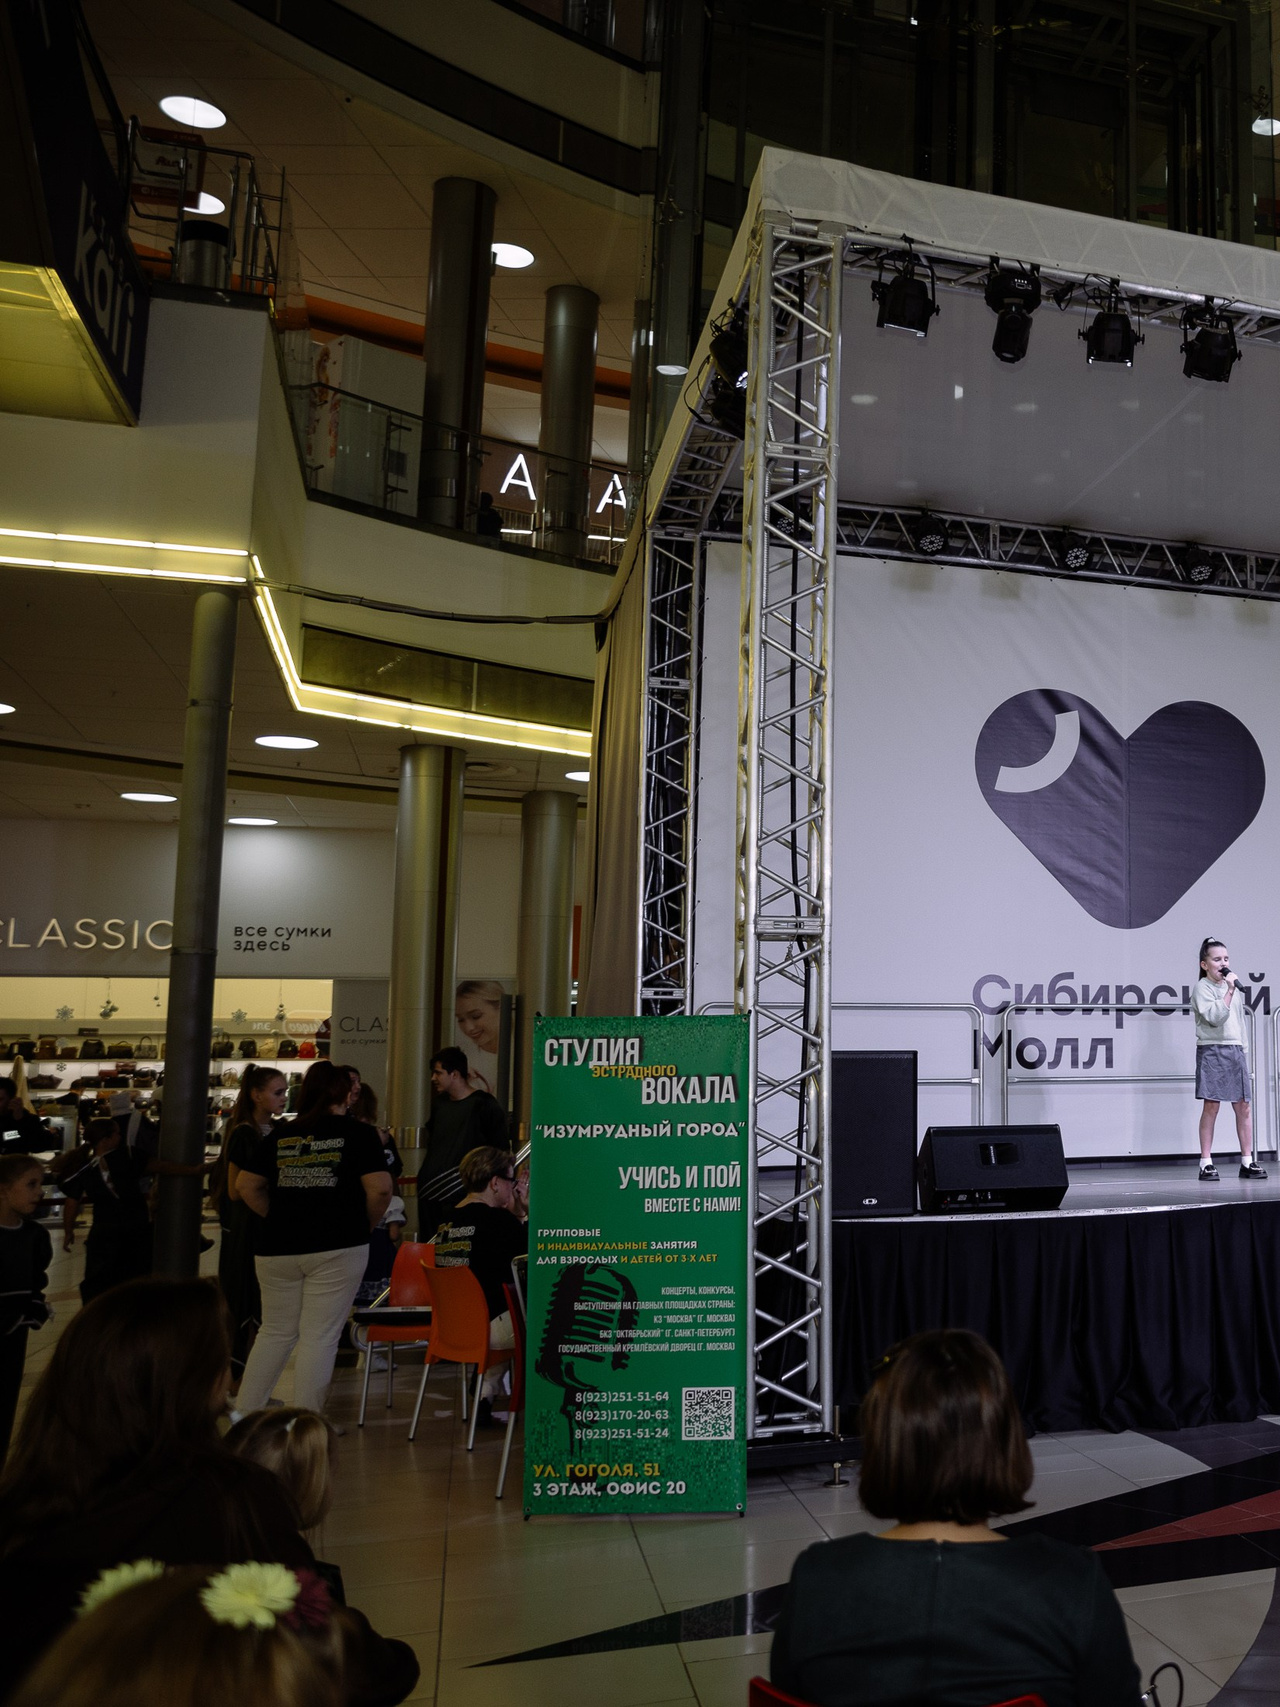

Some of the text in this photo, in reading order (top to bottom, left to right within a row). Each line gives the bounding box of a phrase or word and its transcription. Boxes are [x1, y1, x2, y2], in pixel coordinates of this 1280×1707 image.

[74, 179, 134, 377] kari
[0, 917, 173, 951] LASSIC
[233, 926, 331, 941] все сумки
[233, 940, 291, 952] здесь
[972, 971, 1271, 1029] Сибирсй
[339, 1016, 389, 1032] CLA
[544, 1038, 640, 1068] СТУДИЯ
[973, 1029, 1114, 1070] Молл
[592, 1064, 677, 1081] ЭСТРАДНОГО
[641, 1076, 737, 1105] ВОКАЛА
[618, 1161, 741, 1190] УЧИСЬ И ПОЙ
[644, 1197, 741, 1213] ВМЕСТЕ С НАМИ!
[537, 1228, 601, 1237] ГРУППОВЫЕ
[537, 1241, 698, 1251] И ИНДИВИДУАЛЬНЫЕ ЗАНЯТИЯ
[537, 1256, 557, 1265] ДЛЯ
[560, 1255, 618, 1264] ВЗРОСЛЫХ
[621, 1255, 628, 1263] И
[630, 1253, 662, 1264] ДЕТЕЙ
[665, 1254, 678, 1263] ОТ
[699, 1253, 718, 1263] ЛЕТ
[574, 1302, 622, 1311] ВЫСТУПЛЕНИЯ
[622, 1301, 632, 1310] НА
[633, 1301, 664, 1310] ГЛАВНЫХ
[665, 1300, 707, 1310] ПЛОЩАДКАХ
[707, 1314, 735, 1323] МОСКВА)
[558, 1343, 622, 1353] ГОСУДАРСТВЕННЫЙ
[670, 1342, 696, 1352] ДВОРЕЦ
[706, 1342, 735, 1351] МОСКВА)
[575, 1391, 670, 1404] 8(923)251-51-64
[575, 1409, 669, 1422] 8(923)170-20-63
[574, 1427, 670, 1441] 8(923)251-51-24
[533, 1462, 660, 1479] УЛ. ГОГОЛЯ, 51
[533, 1480, 686, 1498] 3 ЭТАЖ, ОФИС 20
